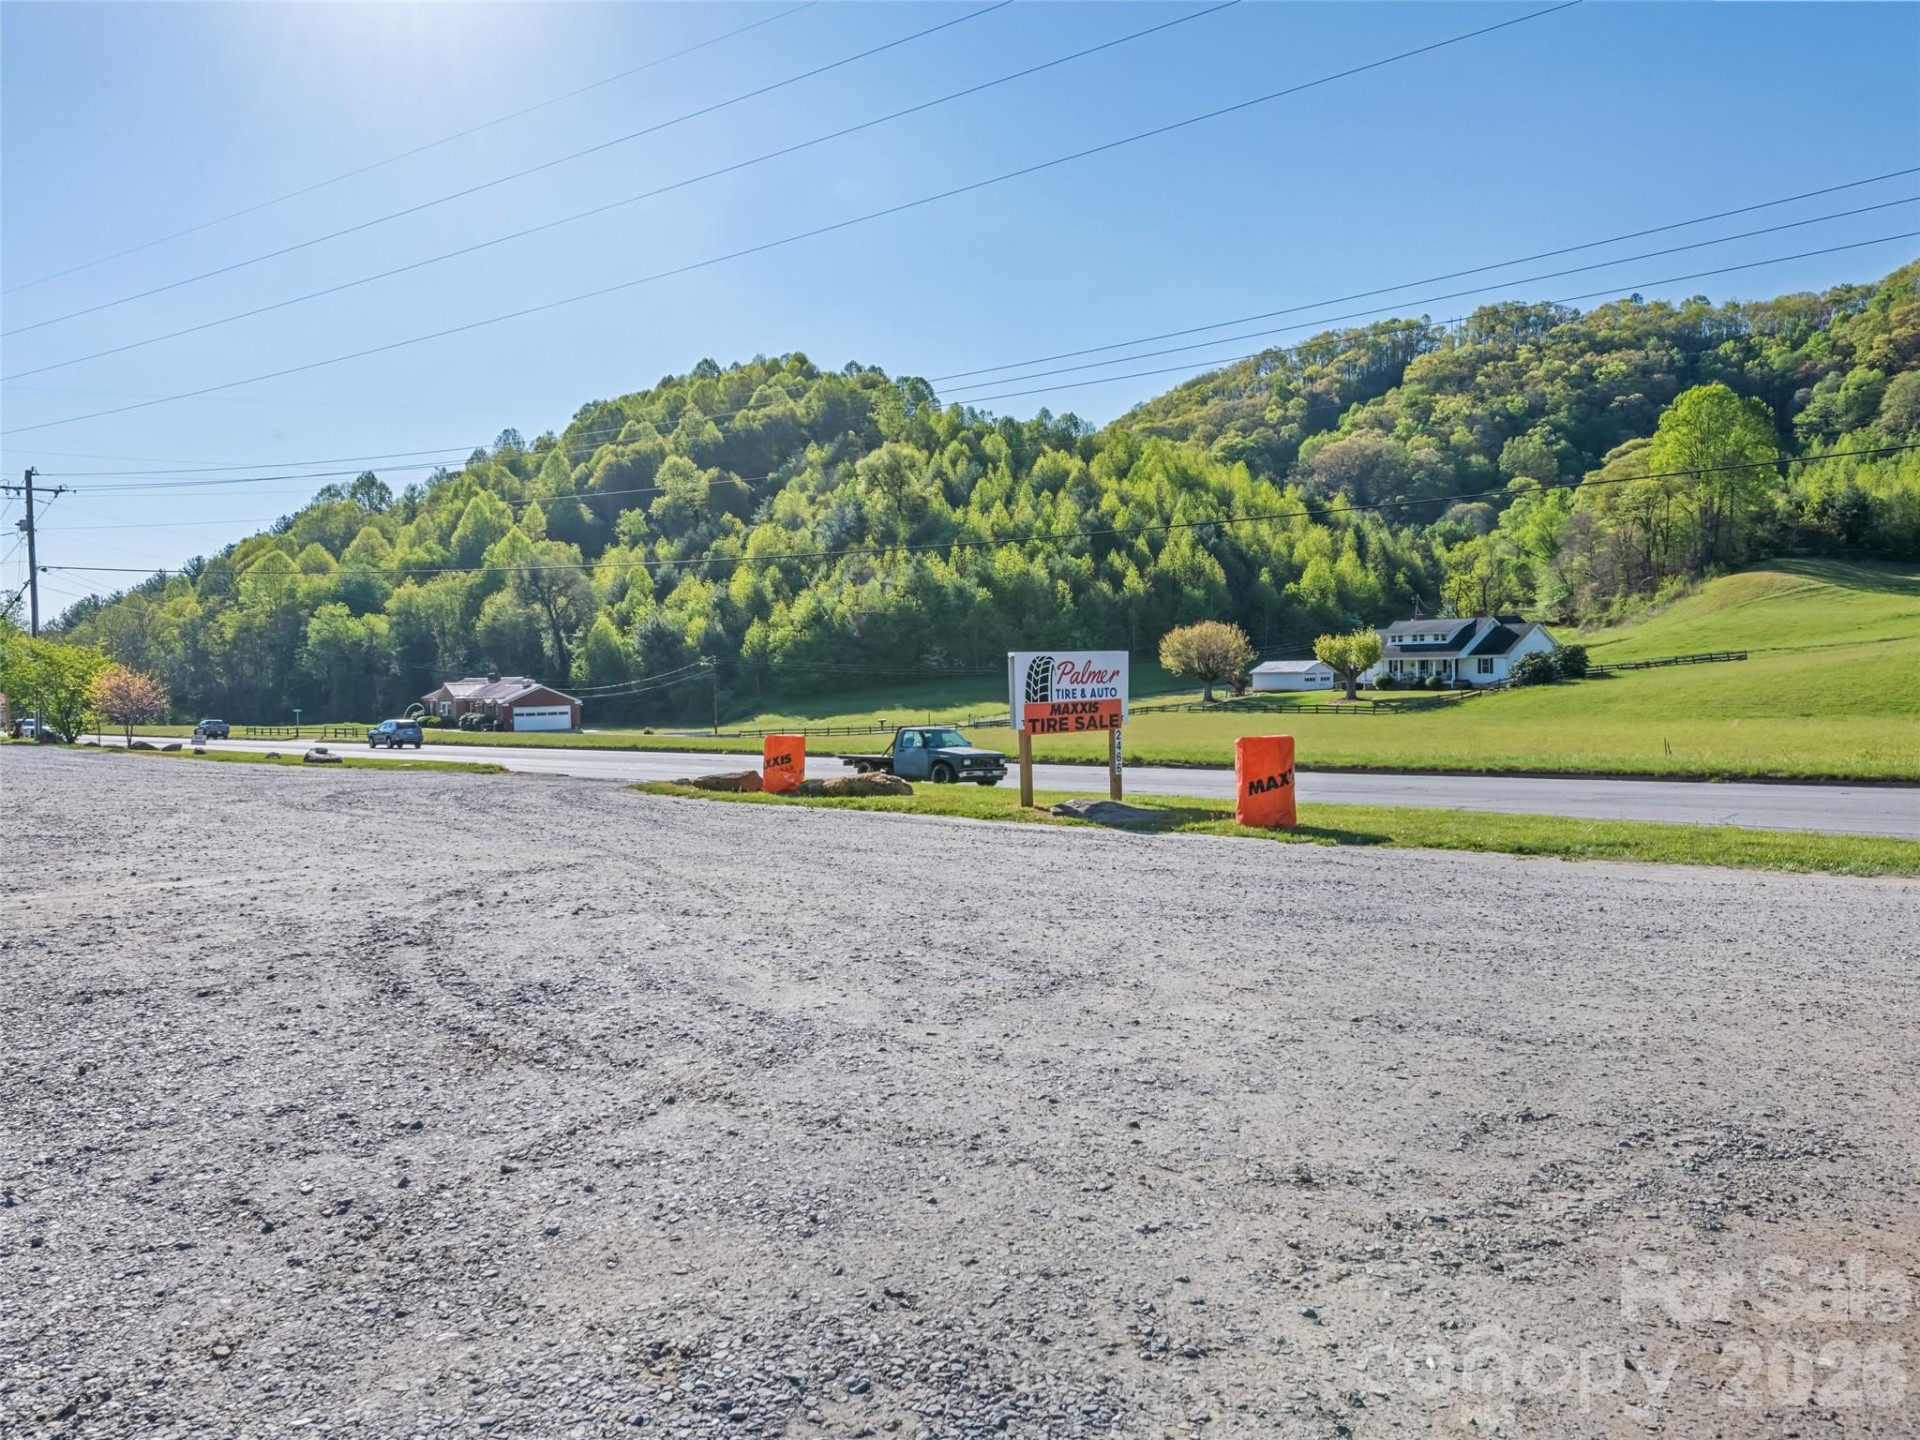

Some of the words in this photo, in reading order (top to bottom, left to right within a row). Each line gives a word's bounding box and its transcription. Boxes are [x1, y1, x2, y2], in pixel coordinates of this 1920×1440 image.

[1057, 660, 1120, 684] Palmer
[1055, 688, 1077, 700] TIRE
[1080, 688, 1087, 698] &
[1090, 687, 1117, 698] AUTO
[1050, 702, 1099, 715] MAXXIS
[1028, 717, 1069, 733] TIRE
[1075, 714, 1119, 730] SALE
